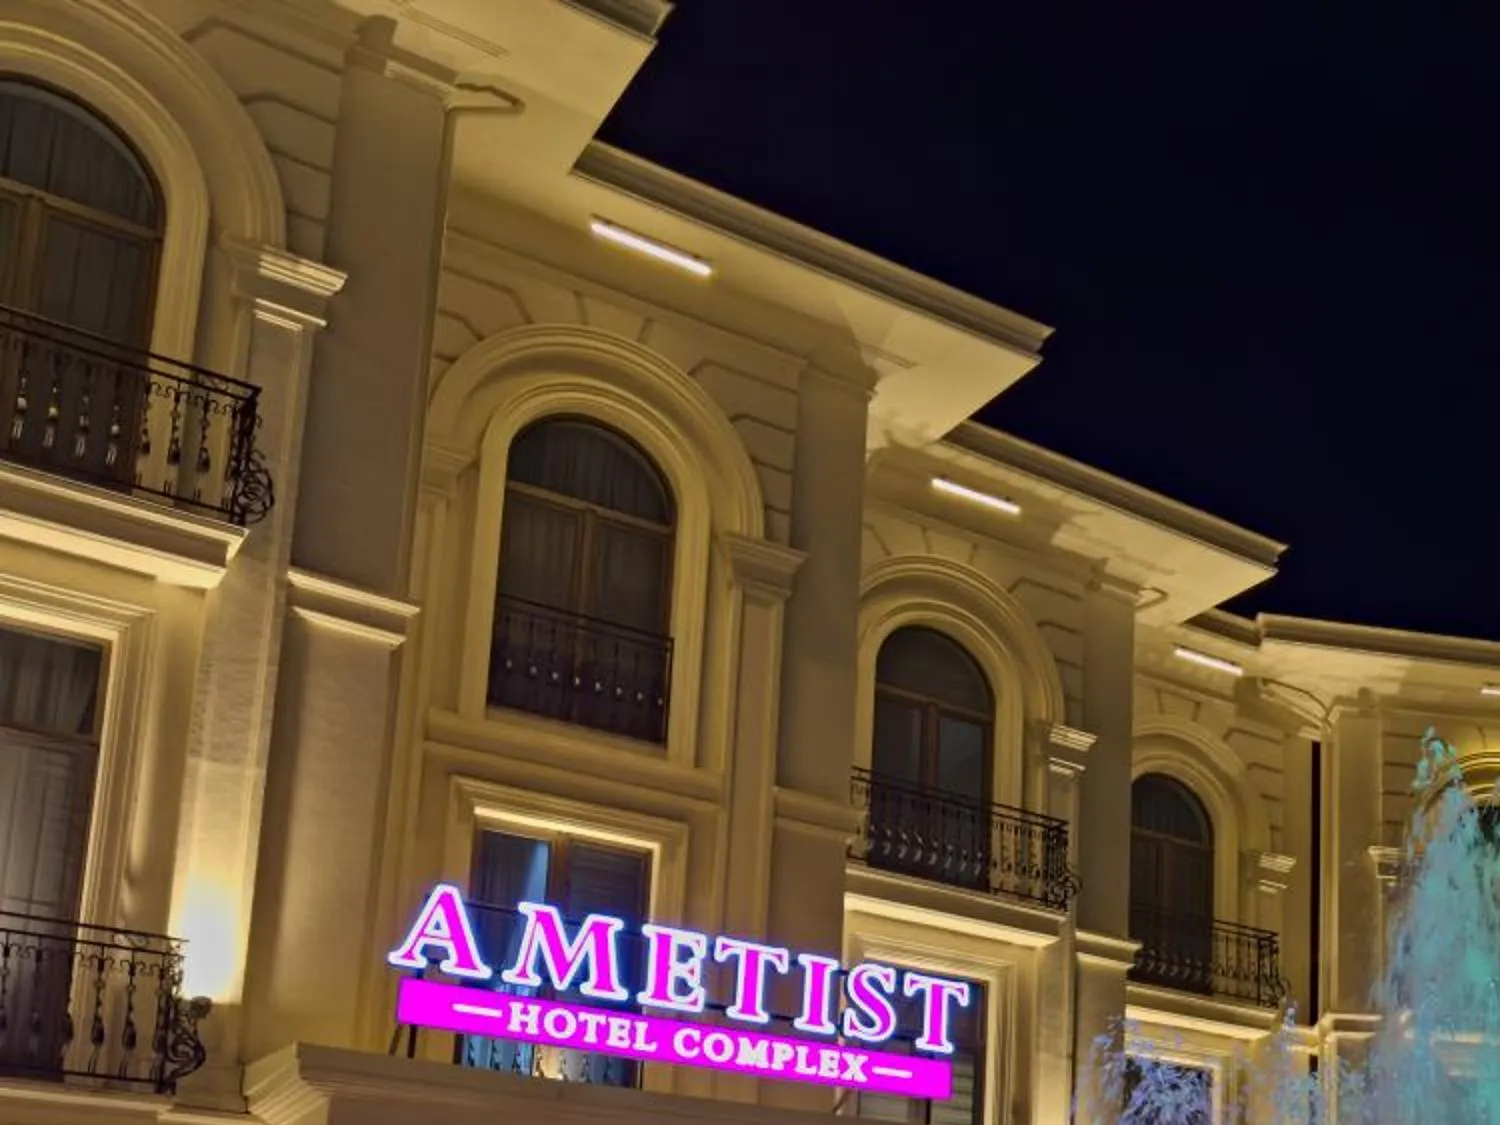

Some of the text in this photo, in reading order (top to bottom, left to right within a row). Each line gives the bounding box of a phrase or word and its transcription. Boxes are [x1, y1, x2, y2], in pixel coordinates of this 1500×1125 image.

[388, 884, 970, 1053] AMETIST
[508, 1002, 870, 1083] HOTEL COMPLEX
